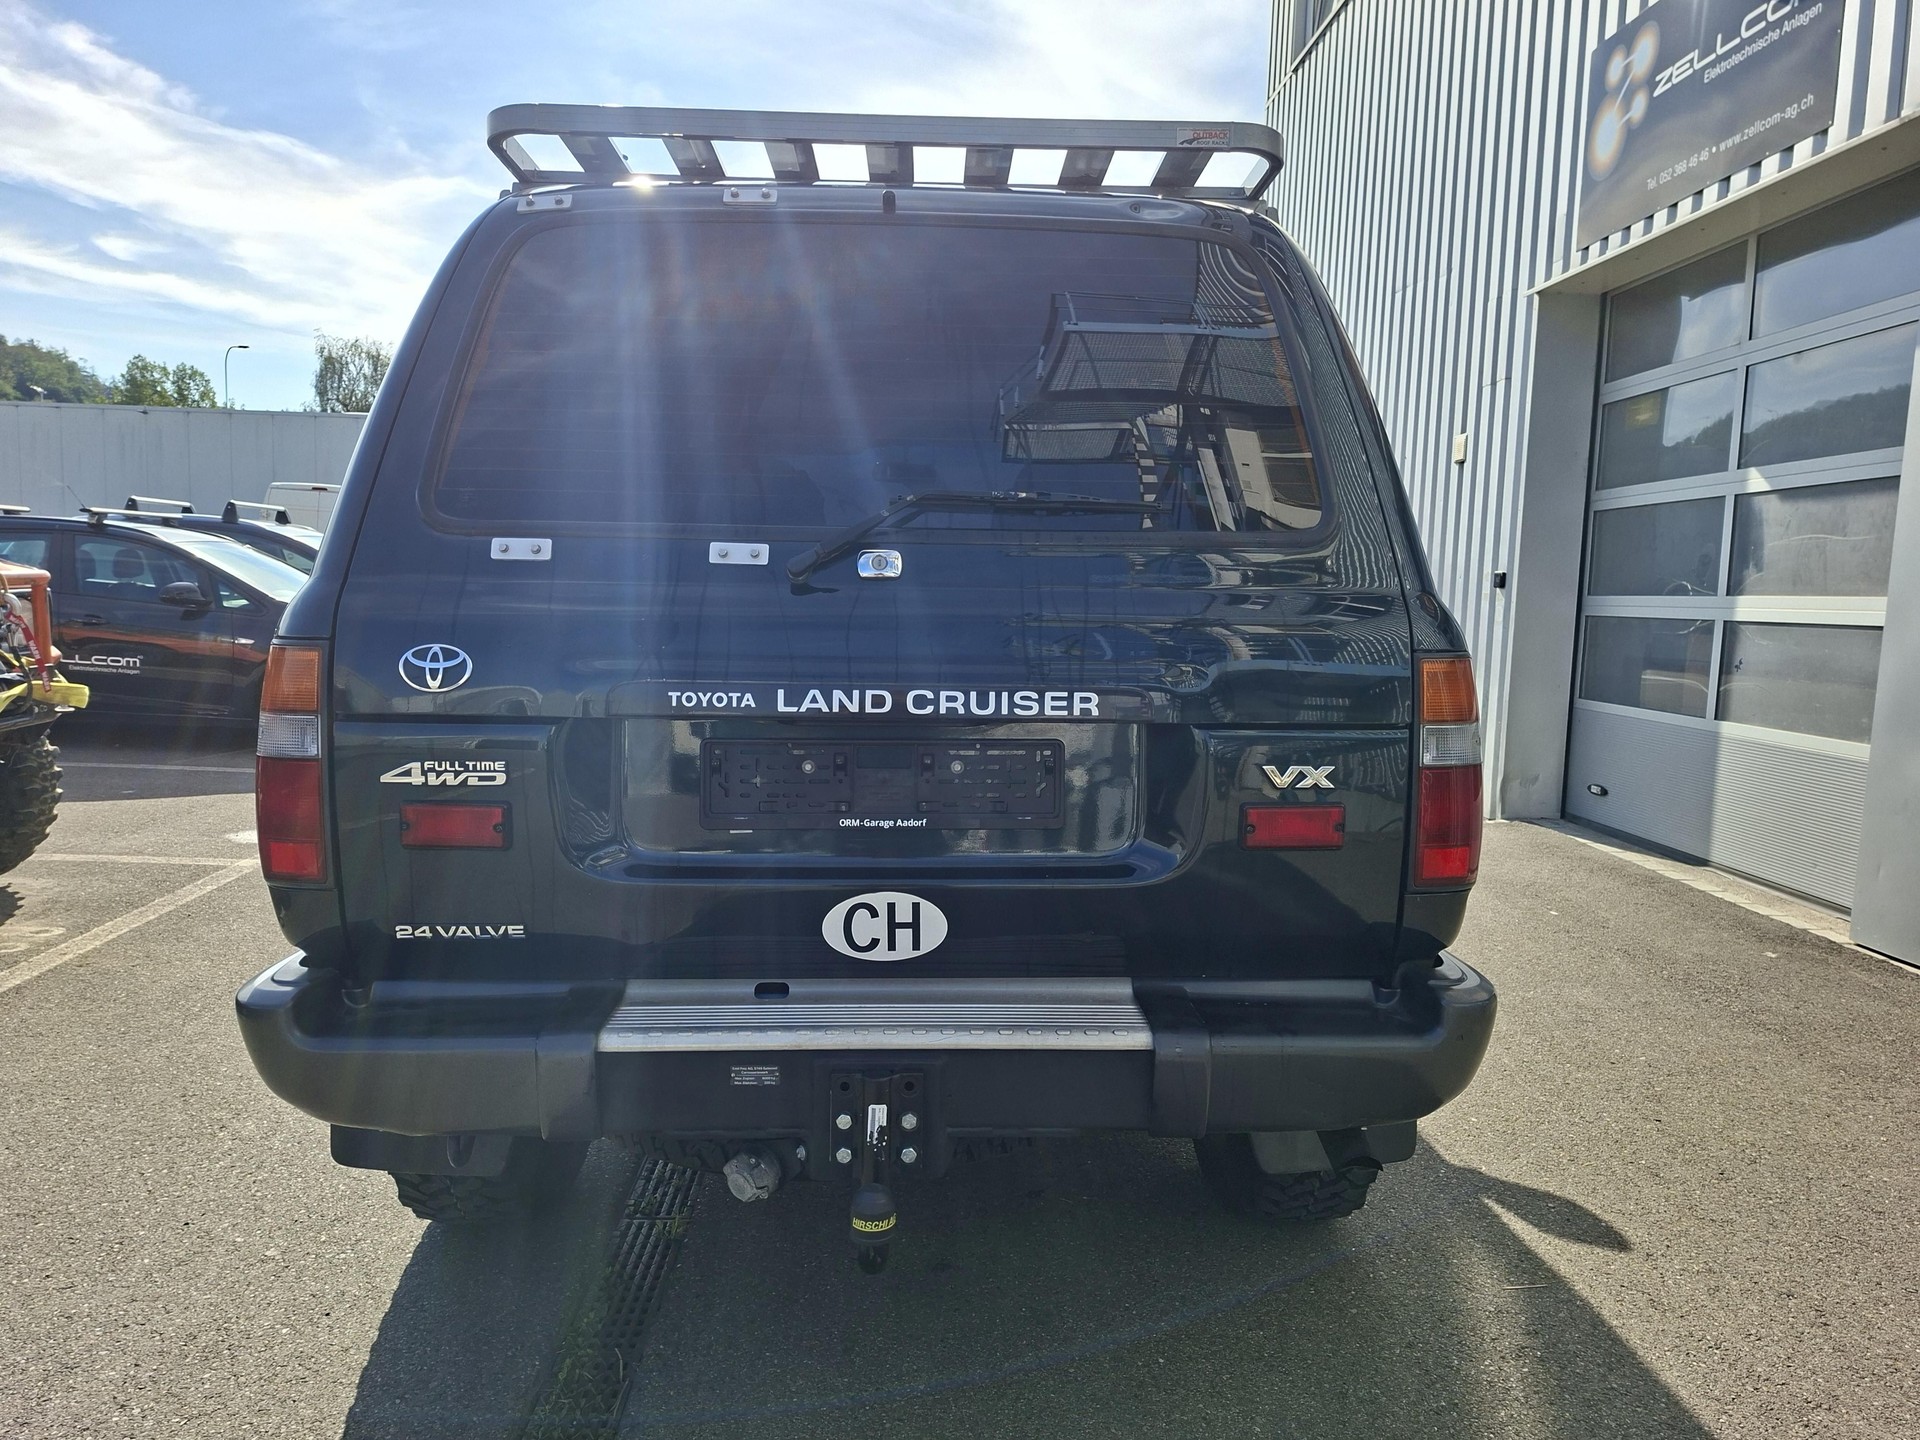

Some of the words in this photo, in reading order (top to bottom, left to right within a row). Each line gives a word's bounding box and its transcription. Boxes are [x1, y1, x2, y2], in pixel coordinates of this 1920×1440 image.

[1653, 0, 1799, 97] ZELLCO
[1703, 28, 1780, 84] Elektrotechnische
[1781, 3, 1823, 36] Anlagen
[1192, 131, 1229, 139] OUTBACK
[1647, 176, 1659, 191] Tel.
[1659, 168, 1673, 185] 052
[1673, 160, 1687, 177] 368
[1688, 155, 1698, 169] 46
[1699, 147, 1709, 162] 46
[1719, 93, 1814, 153] www.zellcom-ag.ch
[668, 691, 756, 708] TOYOTA
[776, 688, 892, 714] LAND
[905, 689, 1100, 717] CRUISER
[380, 762, 507, 786] 4WD
[424, 761, 463, 772] FULL
[465, 761, 506, 772] TIME
[1262, 766, 1336, 788] VX
[839, 818, 895, 829] ORM-Garage
[896, 818, 927, 827] Aadorf
[843, 902, 921, 953] CH
[852, 1216, 889, 1230] HIRSCHI
